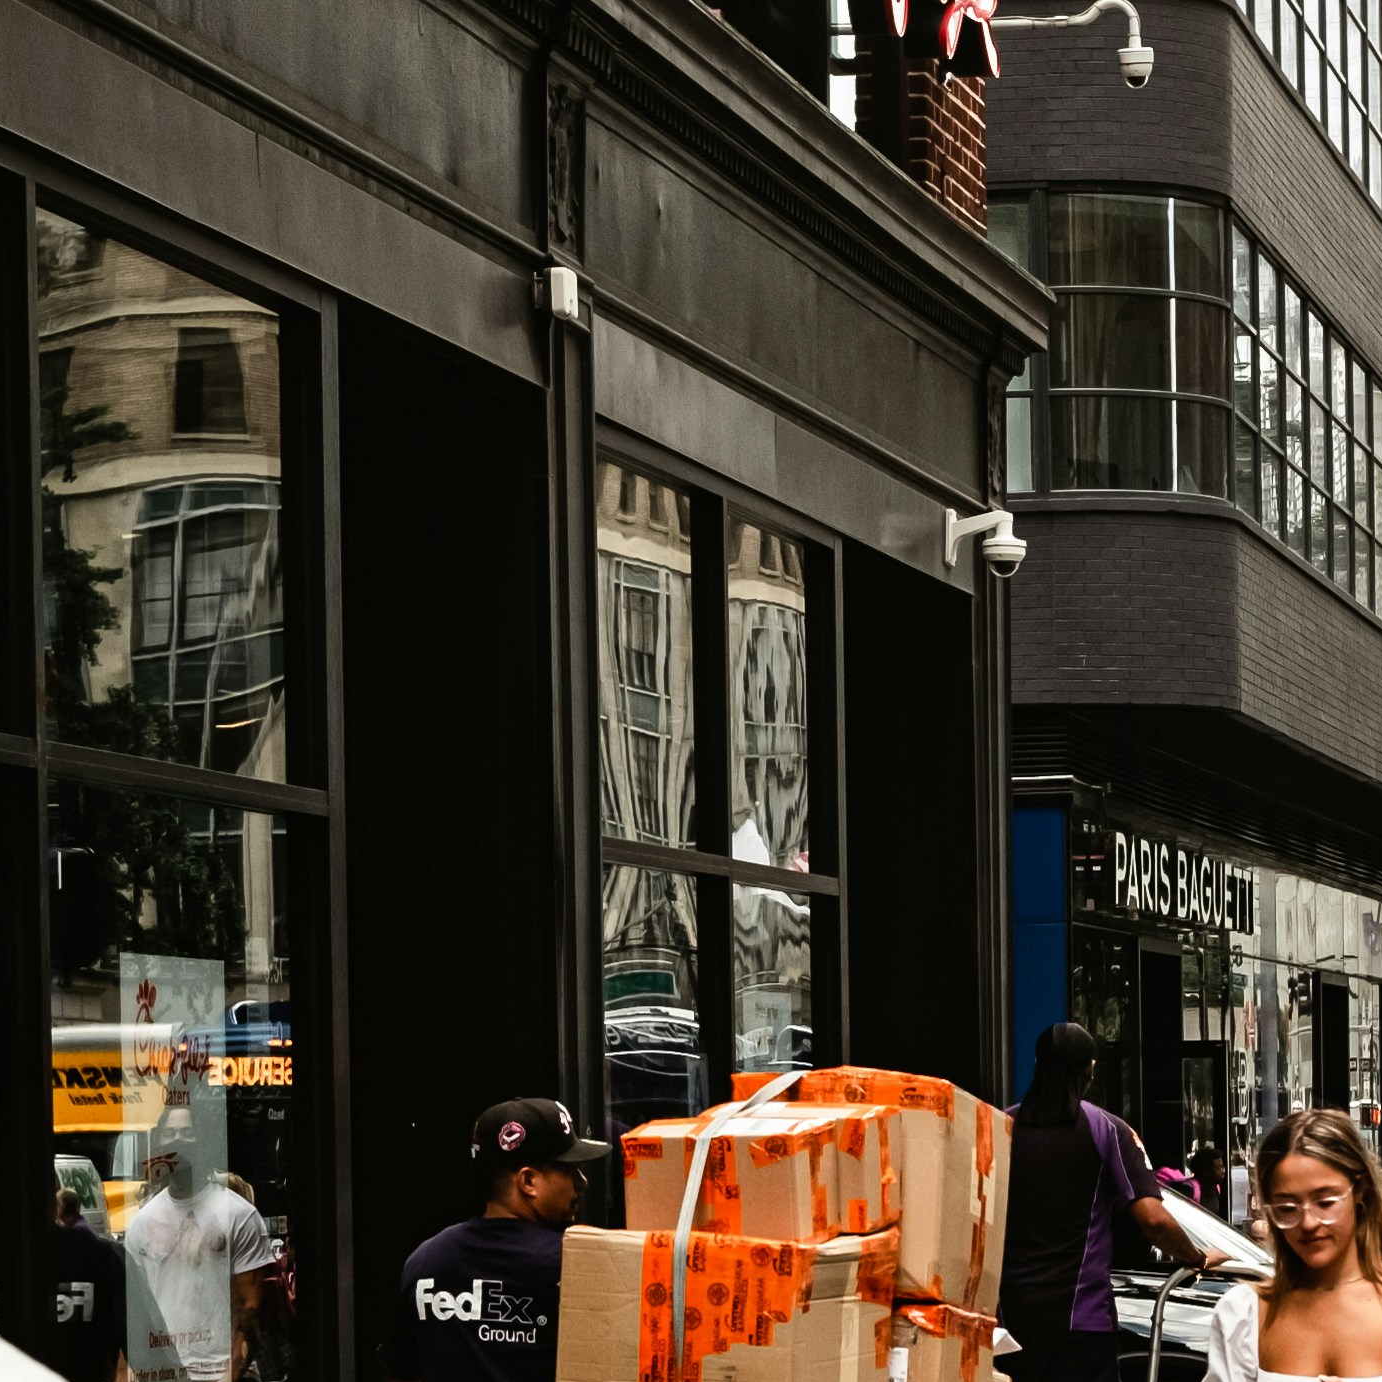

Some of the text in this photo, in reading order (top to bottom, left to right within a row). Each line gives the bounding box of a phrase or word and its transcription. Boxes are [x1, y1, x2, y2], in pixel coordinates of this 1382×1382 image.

[1115, 831, 1171, 916] PARIS
[161, 1086, 191, 1107] Caters
[415, 1278, 534, 1325] FedEx
[479, 1324, 537, 1343] Ground
